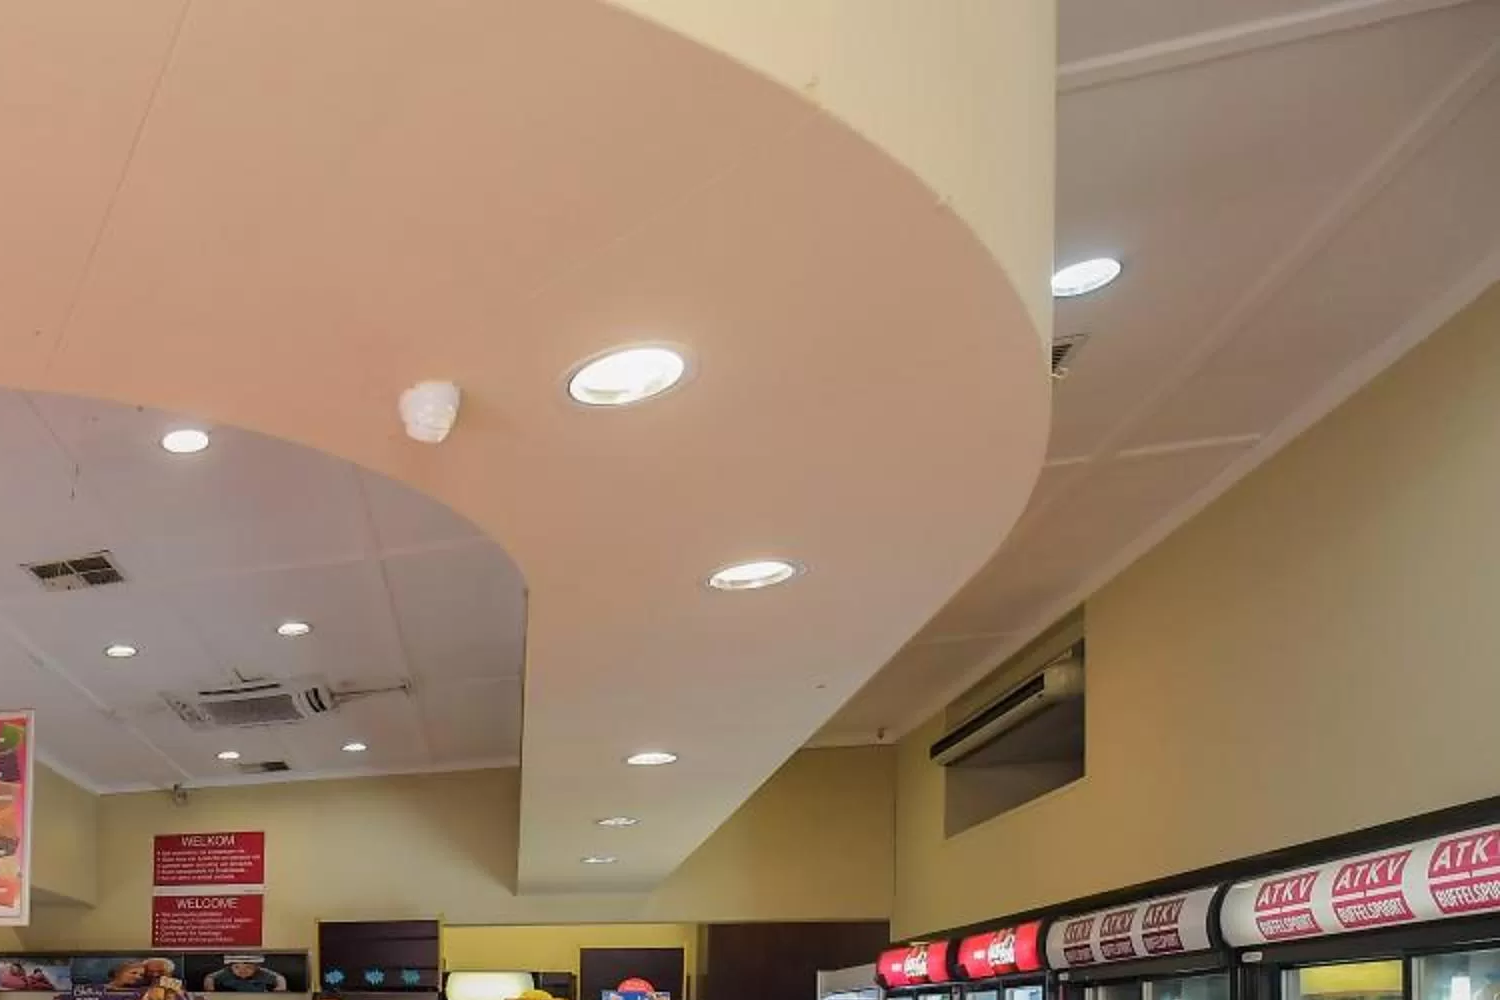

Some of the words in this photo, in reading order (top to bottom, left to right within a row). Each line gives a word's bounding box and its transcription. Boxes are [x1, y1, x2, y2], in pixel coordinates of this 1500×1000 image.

[181, 835, 235, 847] WELKOM
[1433, 836, 1500, 871] ATK
[1335, 856, 1405, 891] ATKV
[176, 897, 238, 909] WELCOME
[1258, 875, 1315, 907] ATKV
